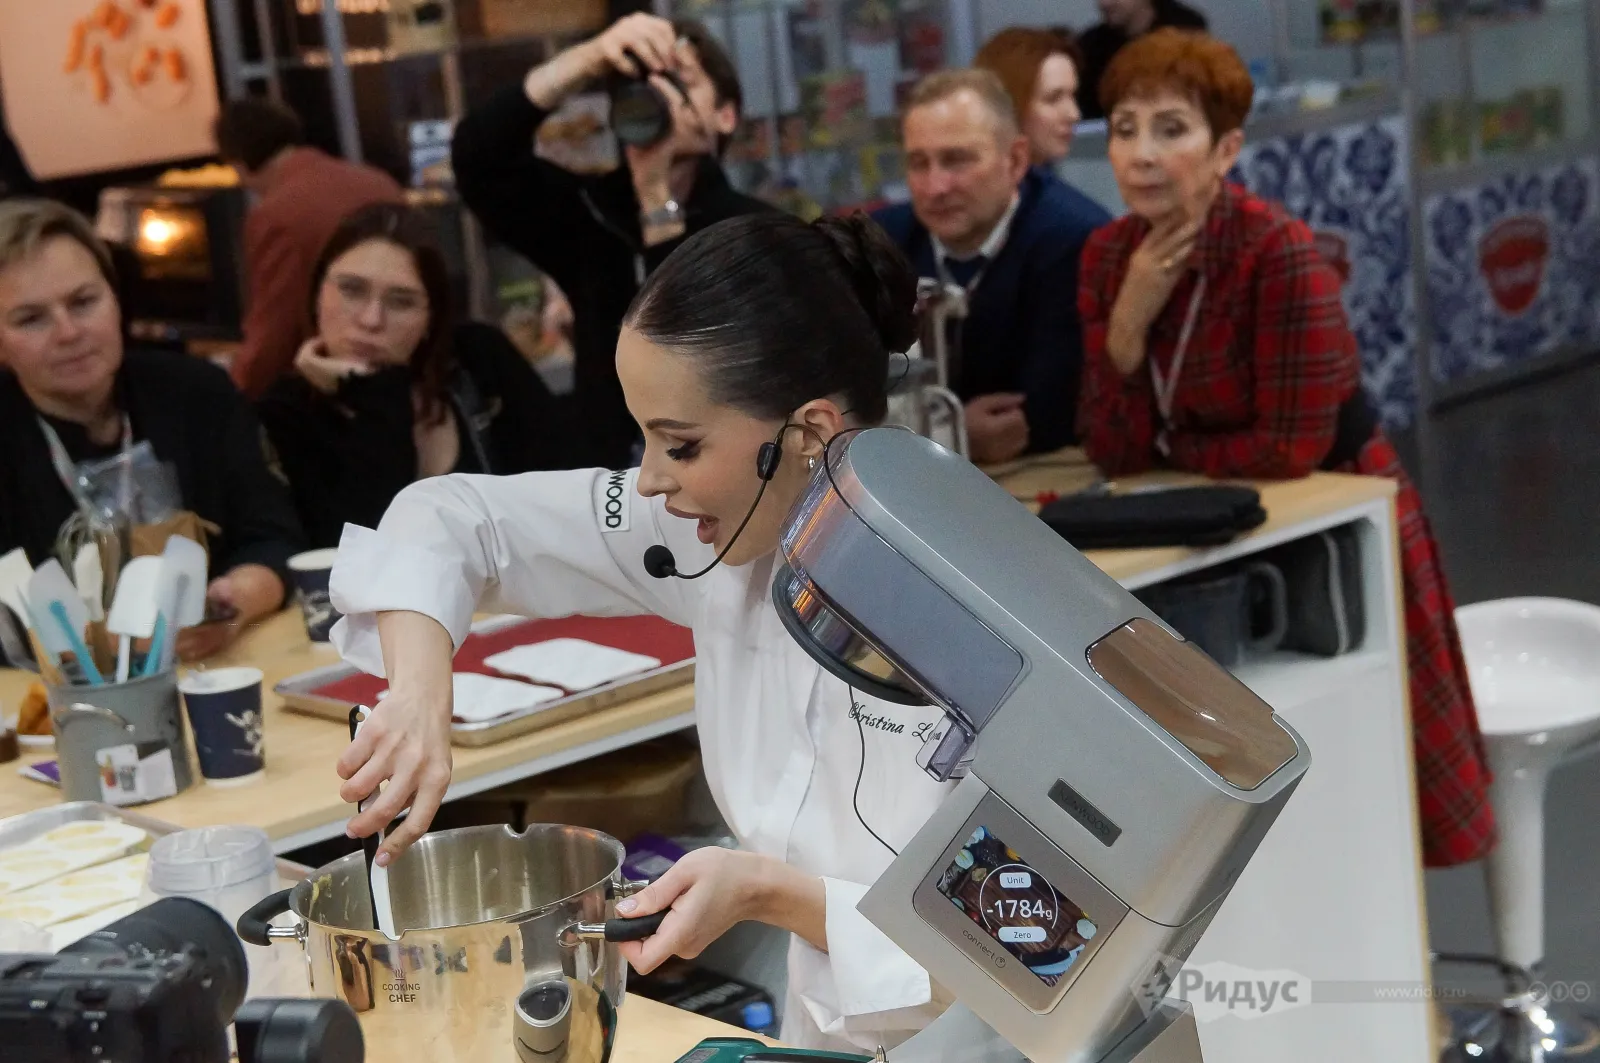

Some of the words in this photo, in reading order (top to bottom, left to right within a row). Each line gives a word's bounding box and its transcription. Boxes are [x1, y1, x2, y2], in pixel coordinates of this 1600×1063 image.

[1006, 876, 1024, 884] Unit
[1013, 931, 1032, 939] Zero
[962, 929, 996, 960] connect
[382, 983, 421, 991] COOKING
[388, 994, 416, 1003] CHEF
